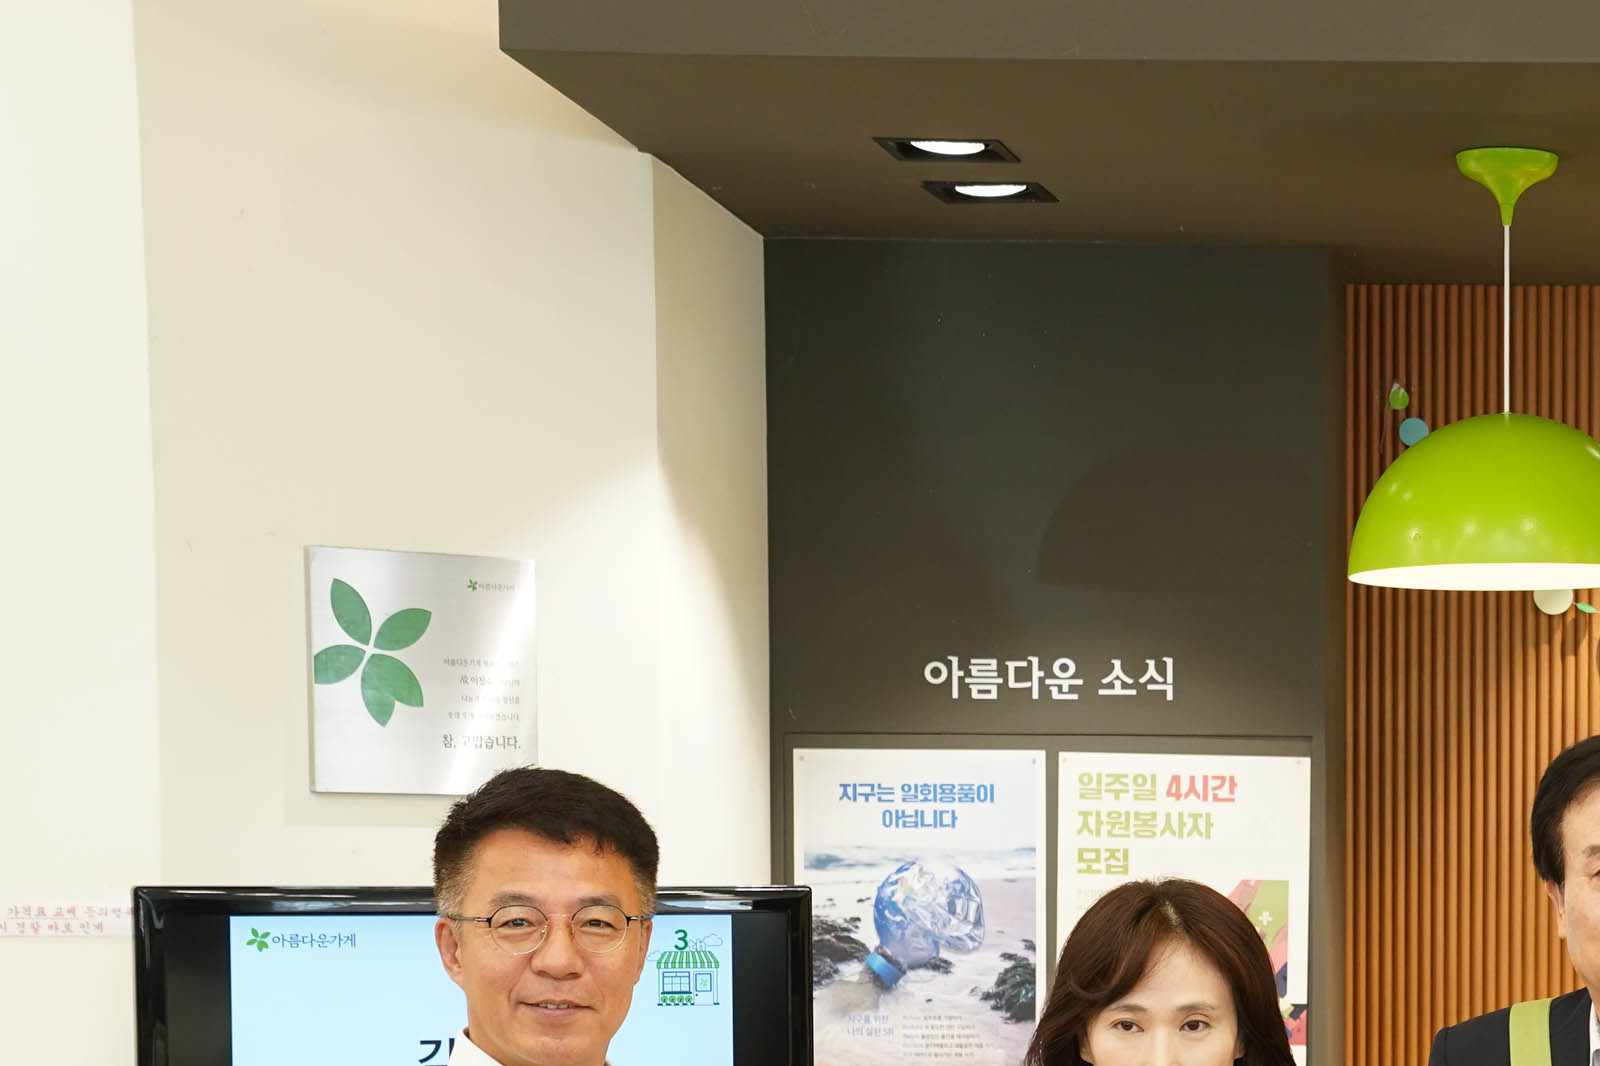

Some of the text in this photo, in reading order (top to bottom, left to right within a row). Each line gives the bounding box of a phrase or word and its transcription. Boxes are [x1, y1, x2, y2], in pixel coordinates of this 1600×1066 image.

[924, 656, 1174, 701] 아름다운 소식
[839, 783, 995, 803] 지구는 일회용품이
[1077, 773, 1238, 802] 일주일 4시간
[882, 809, 958, 829] 아닙니다
[1077, 811, 1214, 839] 자원봉사자
[1077, 848, 1129, 876] 모집
[272, 933, 356, 949] 아름다운가게
